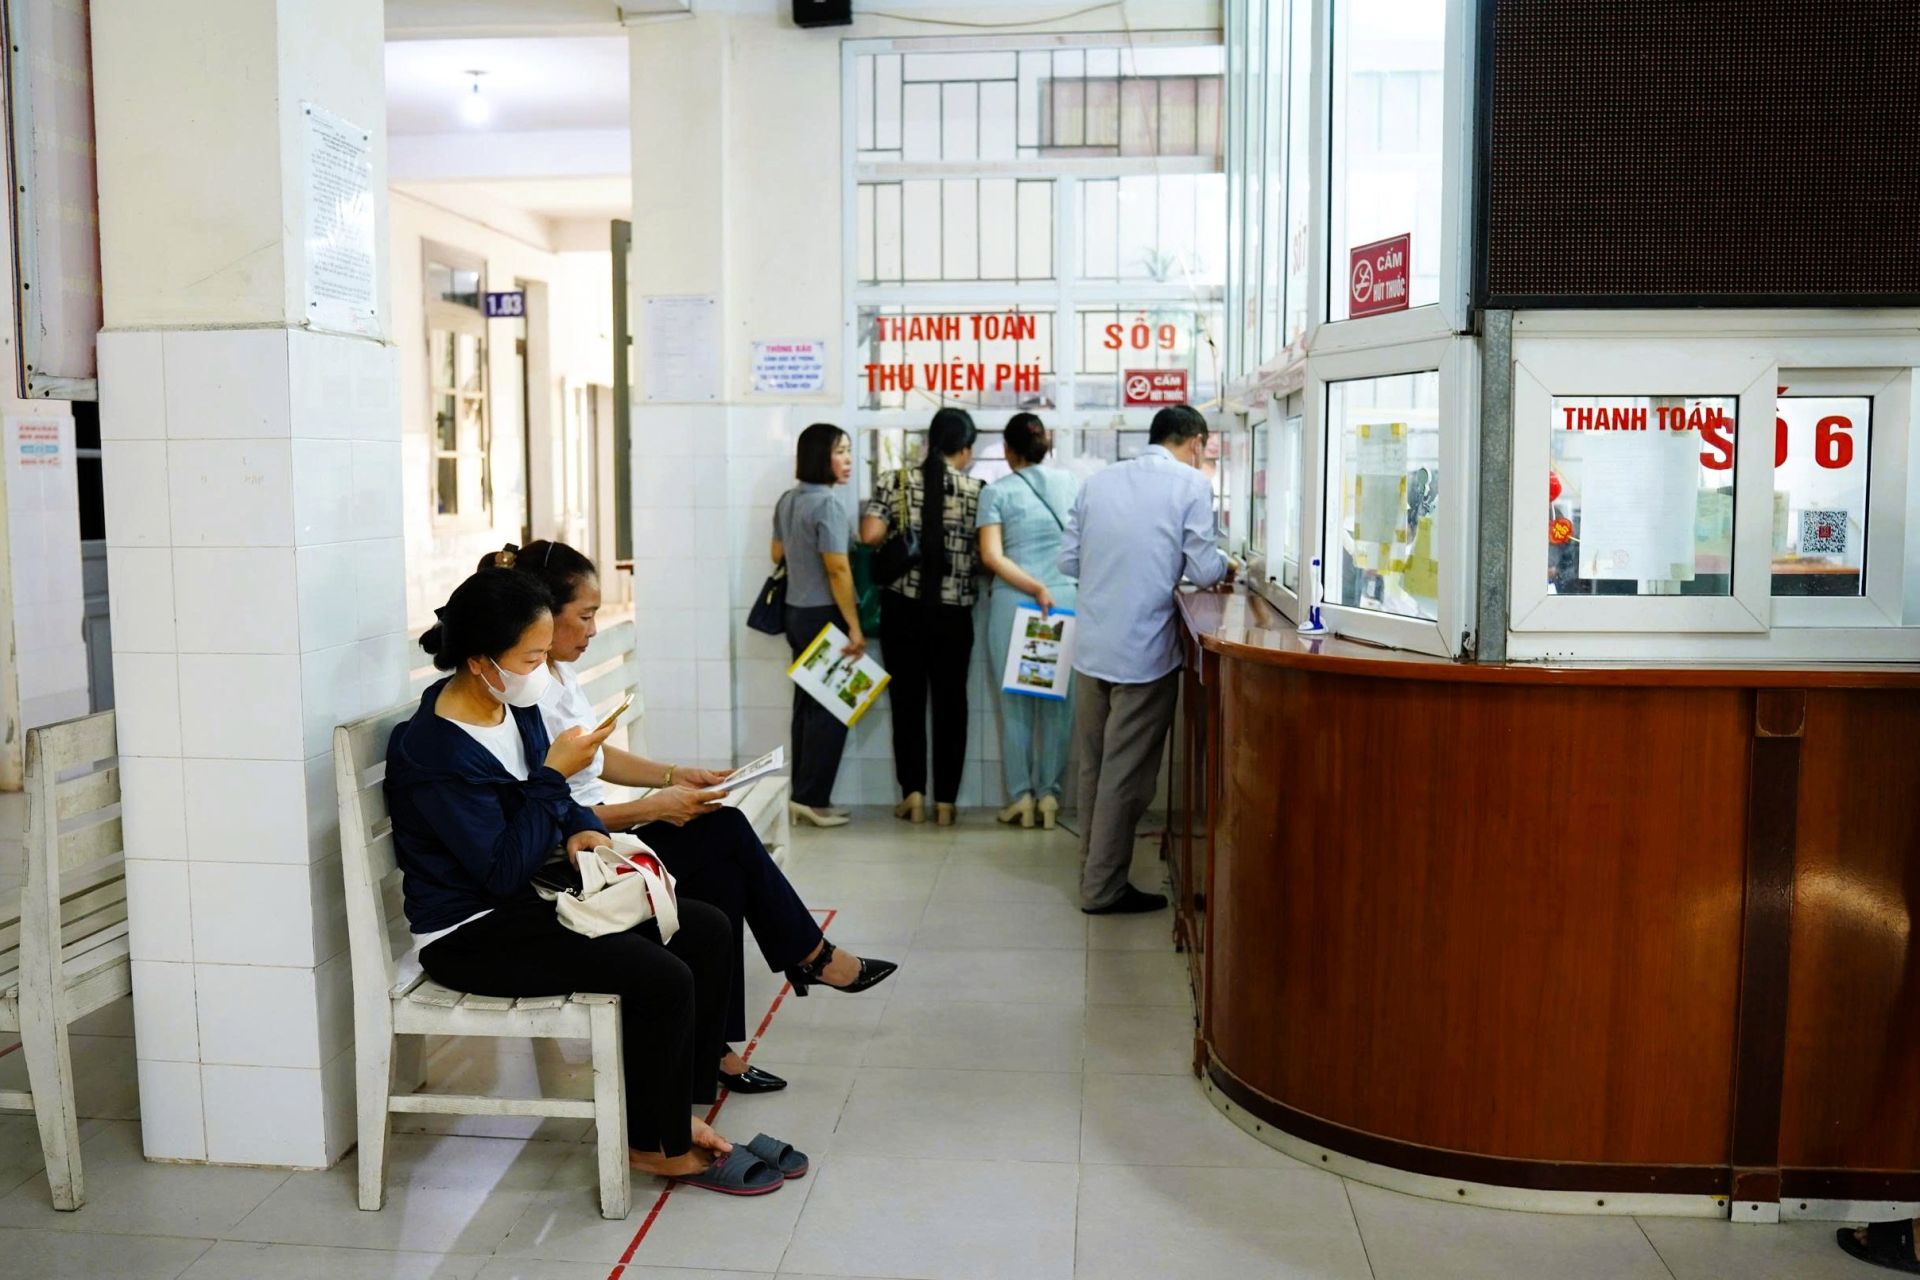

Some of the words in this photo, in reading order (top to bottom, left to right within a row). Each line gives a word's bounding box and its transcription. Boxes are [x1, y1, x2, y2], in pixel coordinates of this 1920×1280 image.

[1377, 247, 1403, 271] CẤM
[1373, 279, 1385, 302] HÚT
[1386, 271, 1405, 299] THUỐC
[487, 294, 522, 315] 1.03
[876, 316, 960, 341] THANH
[970, 309, 1035, 340] TOÁN
[1103, 309, 1150, 350] SỐ
[1158, 323, 1176, 350] 9
[865, 363, 914, 392] THU
[924, 356, 985, 399] VIỆN
[995, 356, 1041, 392] PHÍ
[1153, 375, 1182, 386] CẤM
[1563, 406, 1647, 431] THANH
[1656, 401, 1723, 431] TOÁN
[1815, 415, 1854, 469] 6
